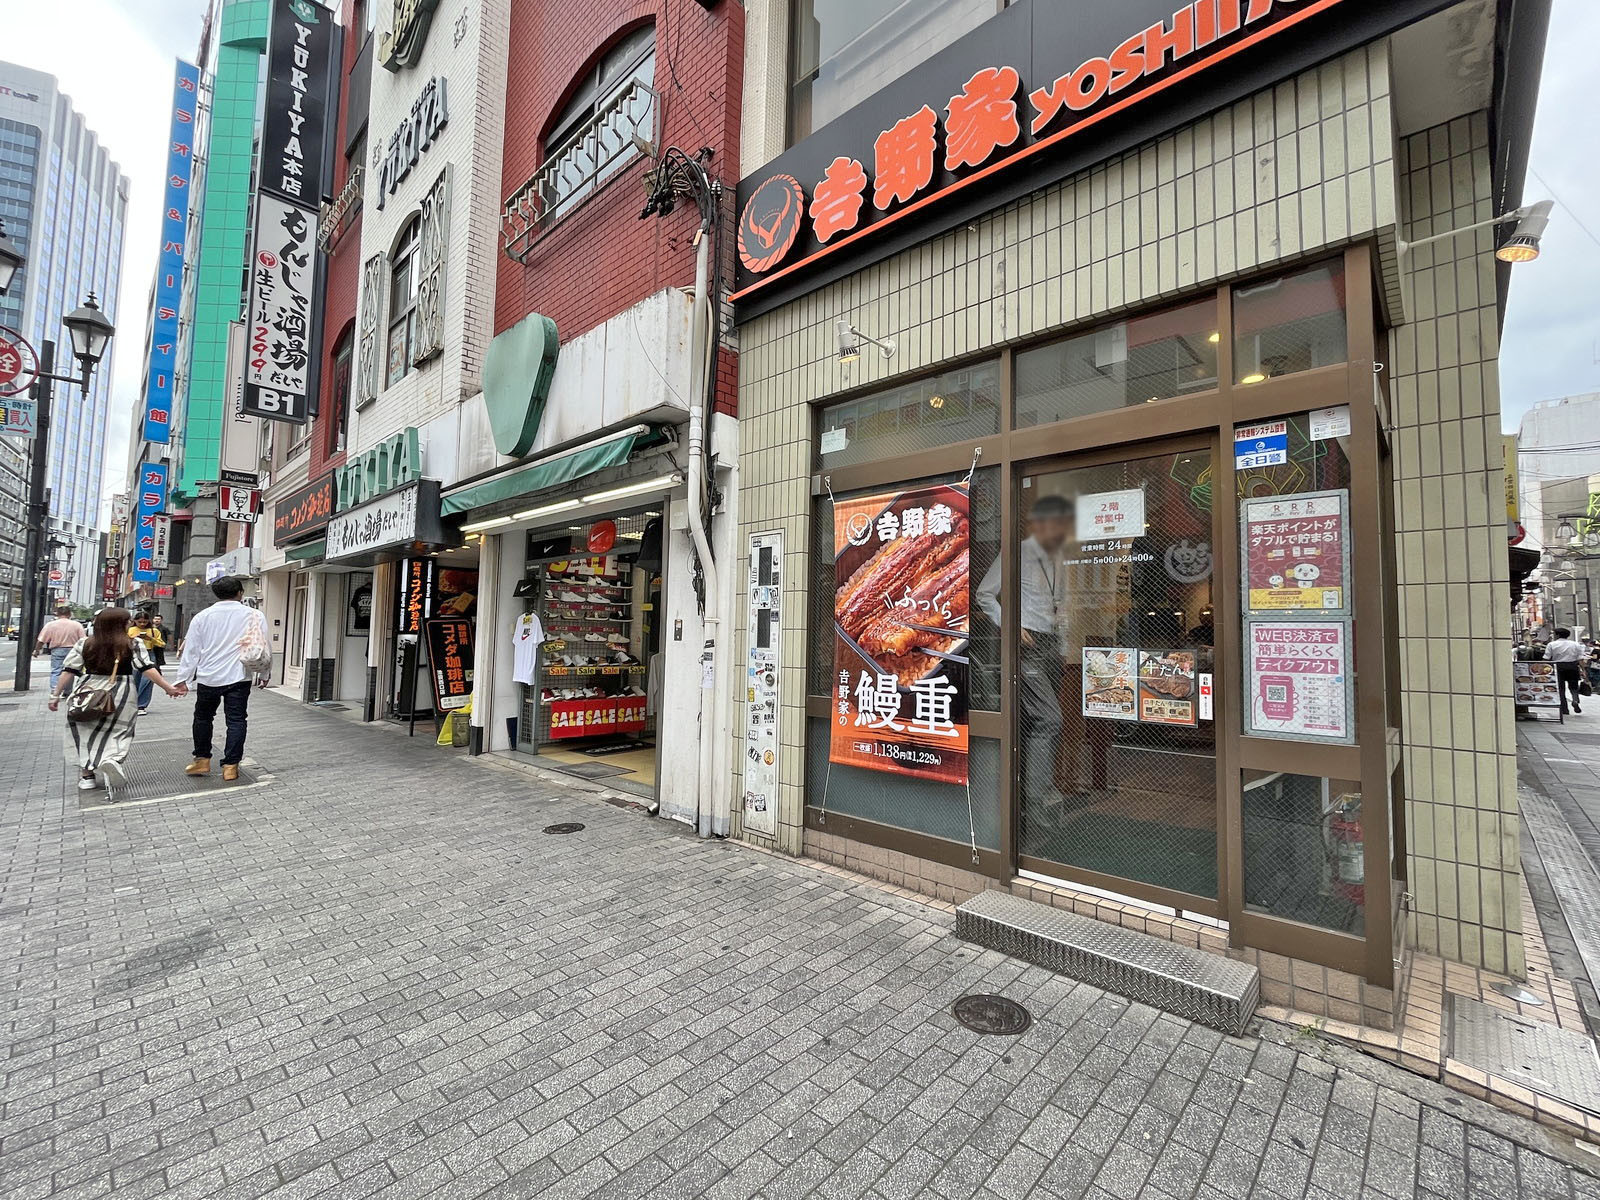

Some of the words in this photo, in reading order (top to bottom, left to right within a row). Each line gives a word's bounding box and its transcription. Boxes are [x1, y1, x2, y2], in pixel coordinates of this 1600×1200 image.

[1029, 0, 1297, 136] YOSHIN
[257, 387, 295, 415] B1
[1101, 501, 1120, 512] 2階
[226, 511, 252, 521] KFC
[1094, 513, 1125, 525] 営業中
[1251, 518, 1337, 536] 楽天ポイントが
[895, 586, 954, 620] ふっくら
[1258, 629, 1337, 642] WEB決済で
[1258, 643, 1335, 657] 簡単らくらく
[1141, 660, 1185, 677] 牛たん
[1258, 659, 1336, 673] テイクアウト
[853, 668, 960, 738] 鰻重
[551, 711, 585, 728] SALE
[585, 708, 616, 725] SALE
[617, 706, 646, 722] SALE
